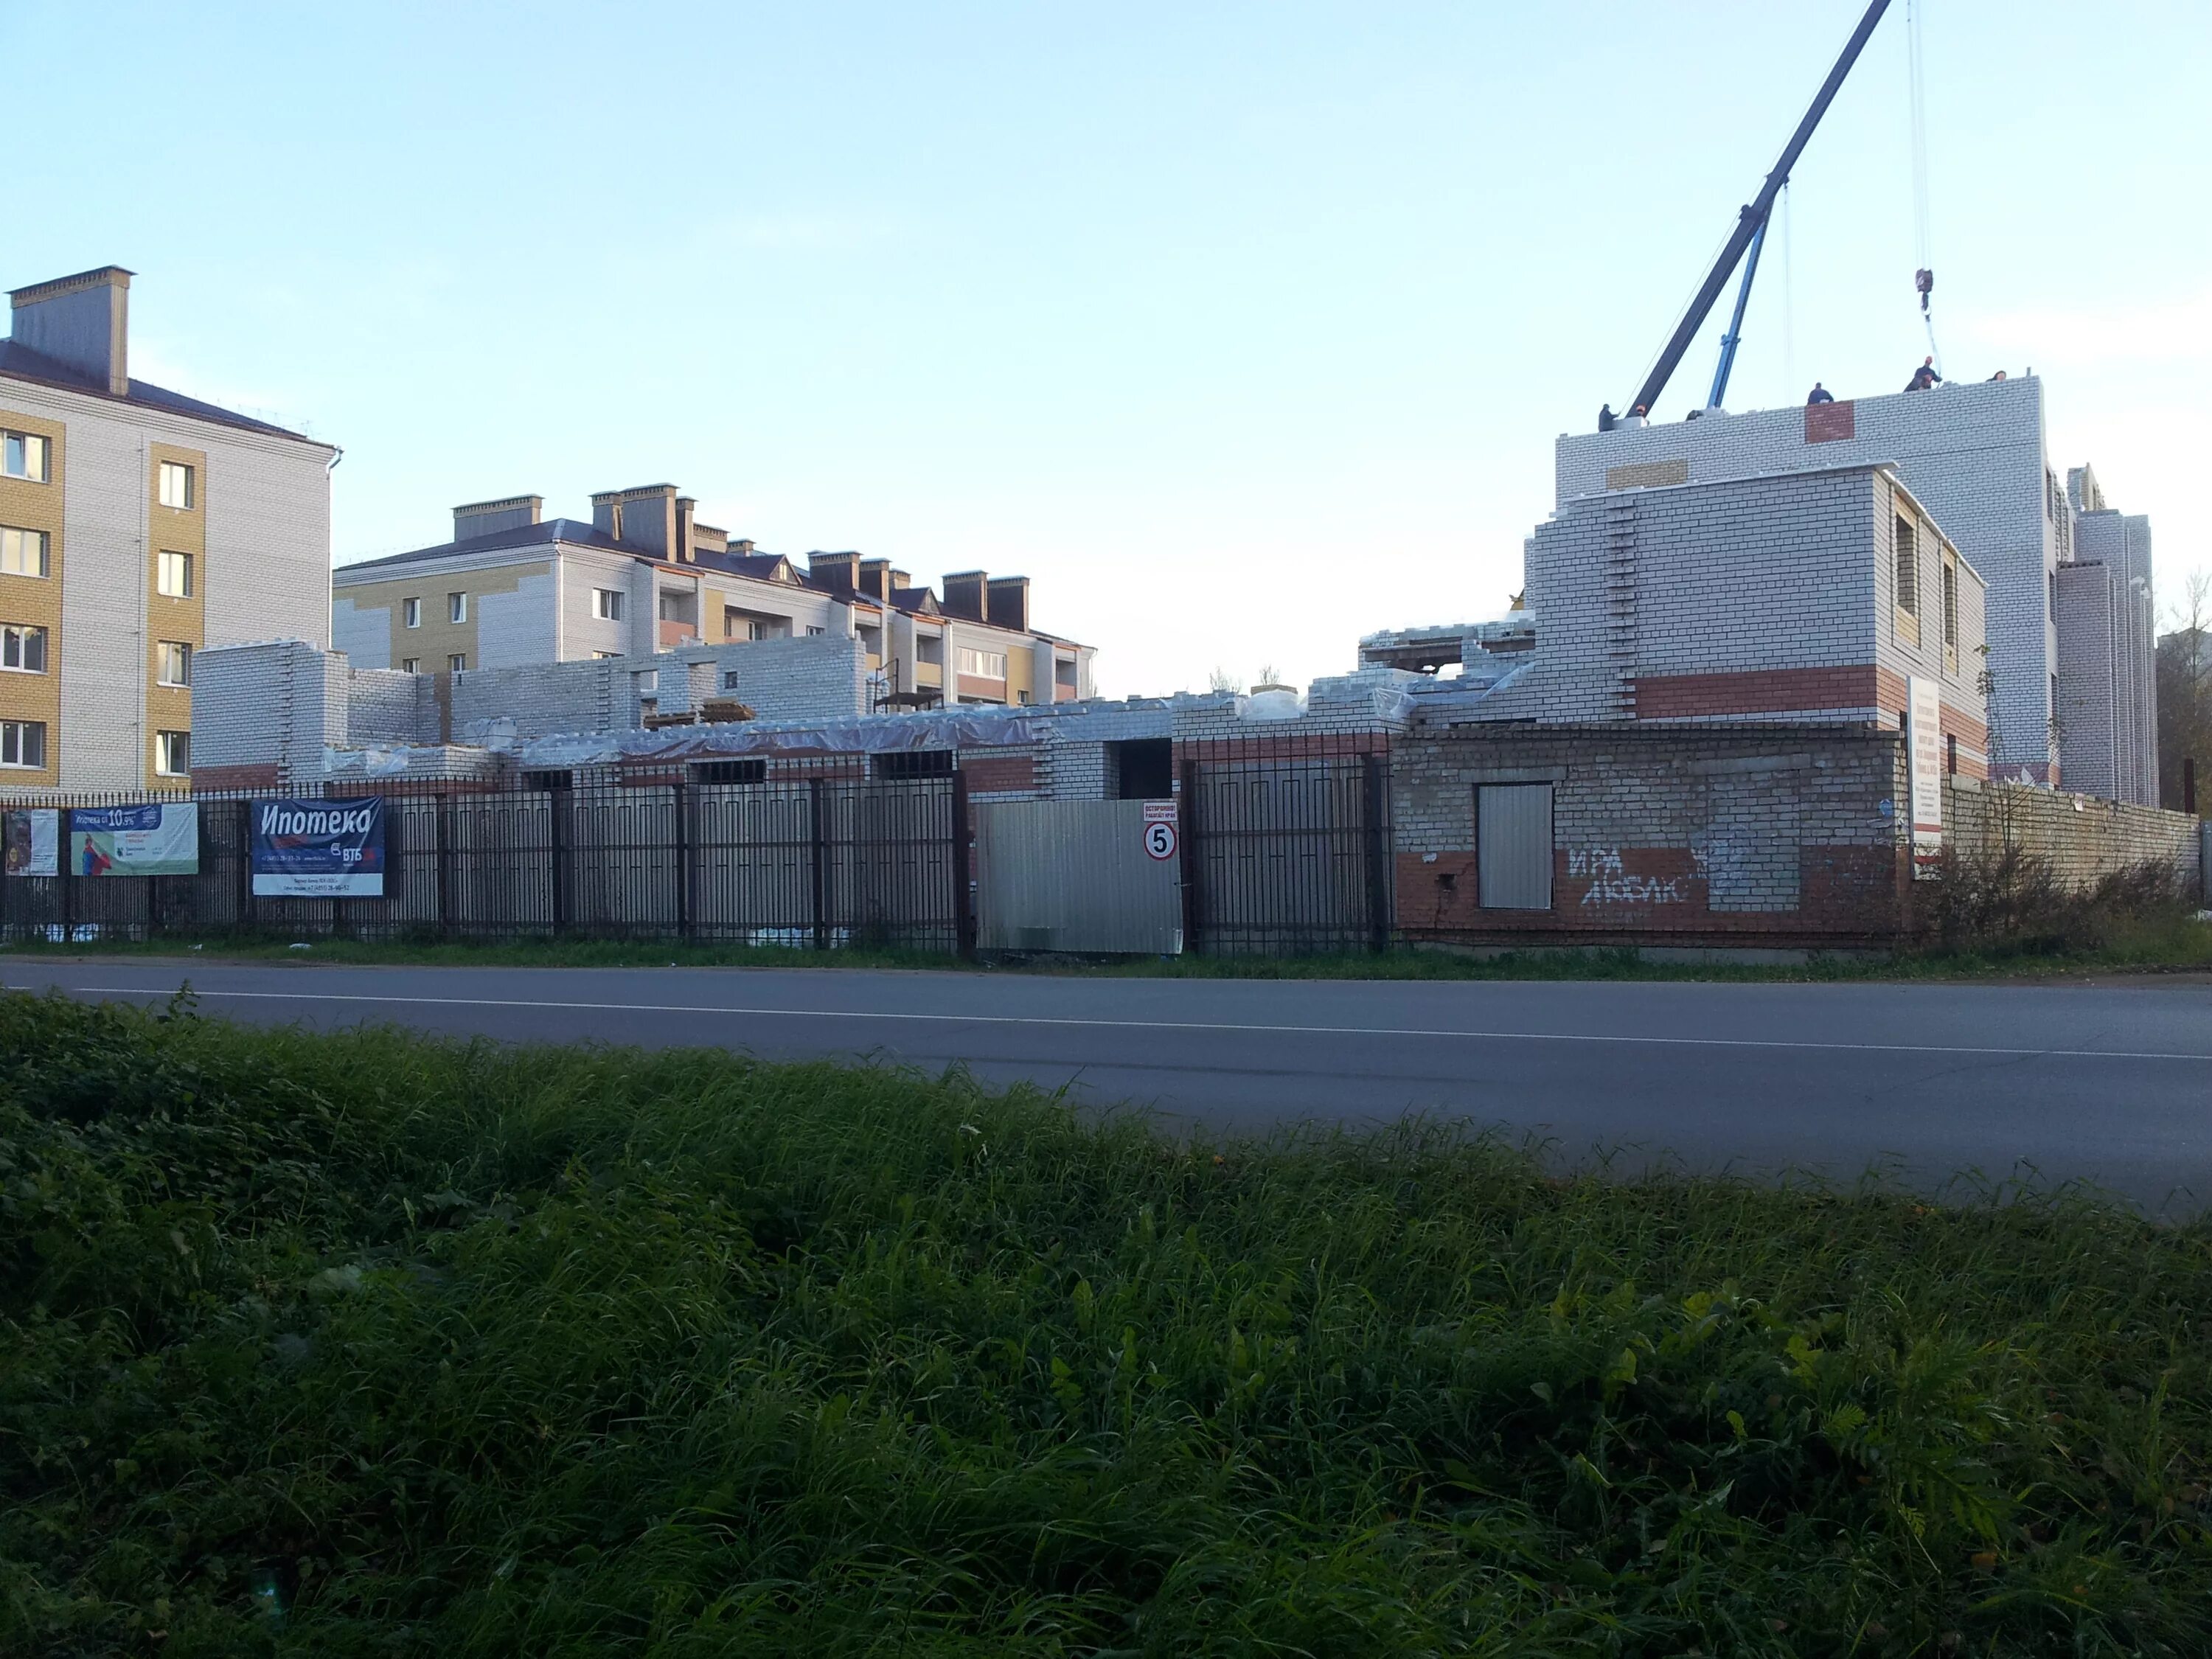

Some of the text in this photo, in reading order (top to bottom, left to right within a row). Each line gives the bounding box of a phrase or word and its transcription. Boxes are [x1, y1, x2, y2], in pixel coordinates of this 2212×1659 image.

[261, 804, 372, 835] Ипотека
[1153, 828, 1167, 853] 5
[343, 848, 362, 862] ВТБ
[1569, 848, 1624, 877] ИРА
